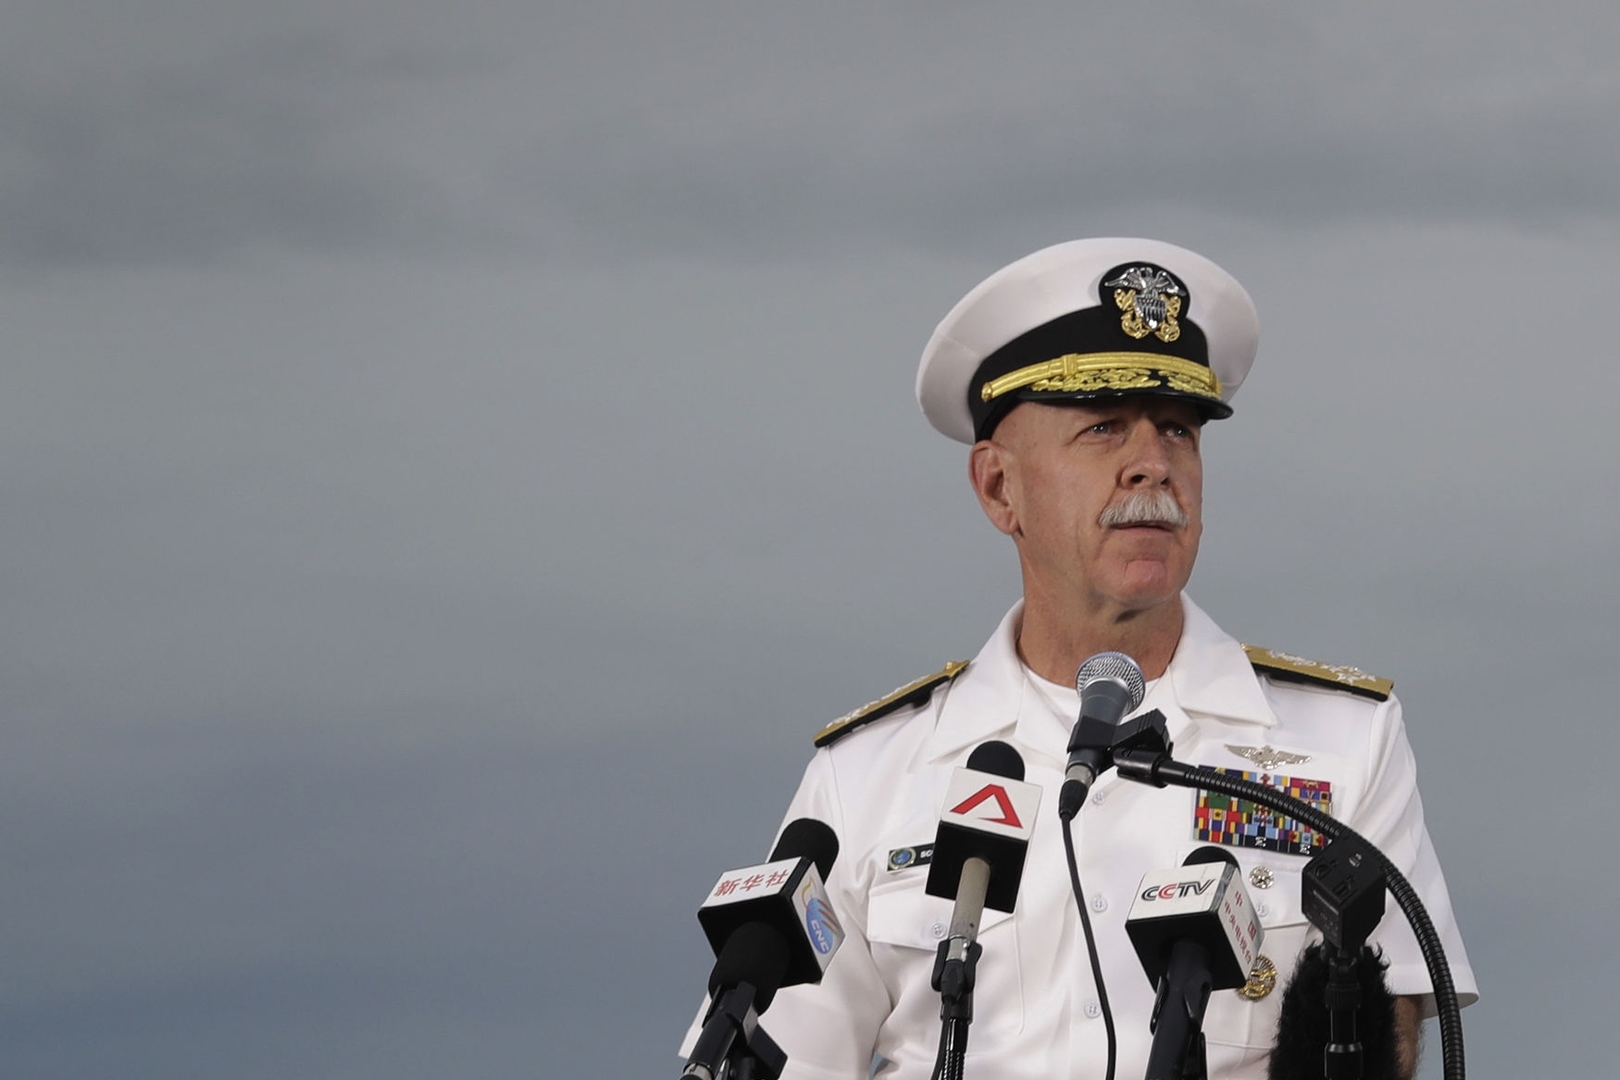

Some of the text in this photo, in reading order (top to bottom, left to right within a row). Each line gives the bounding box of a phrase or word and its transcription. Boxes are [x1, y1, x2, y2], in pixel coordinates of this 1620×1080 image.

[714, 869, 788, 896] 新华社
[1141, 878, 1216, 902] CCTV
[811, 919, 830, 952] CNC
